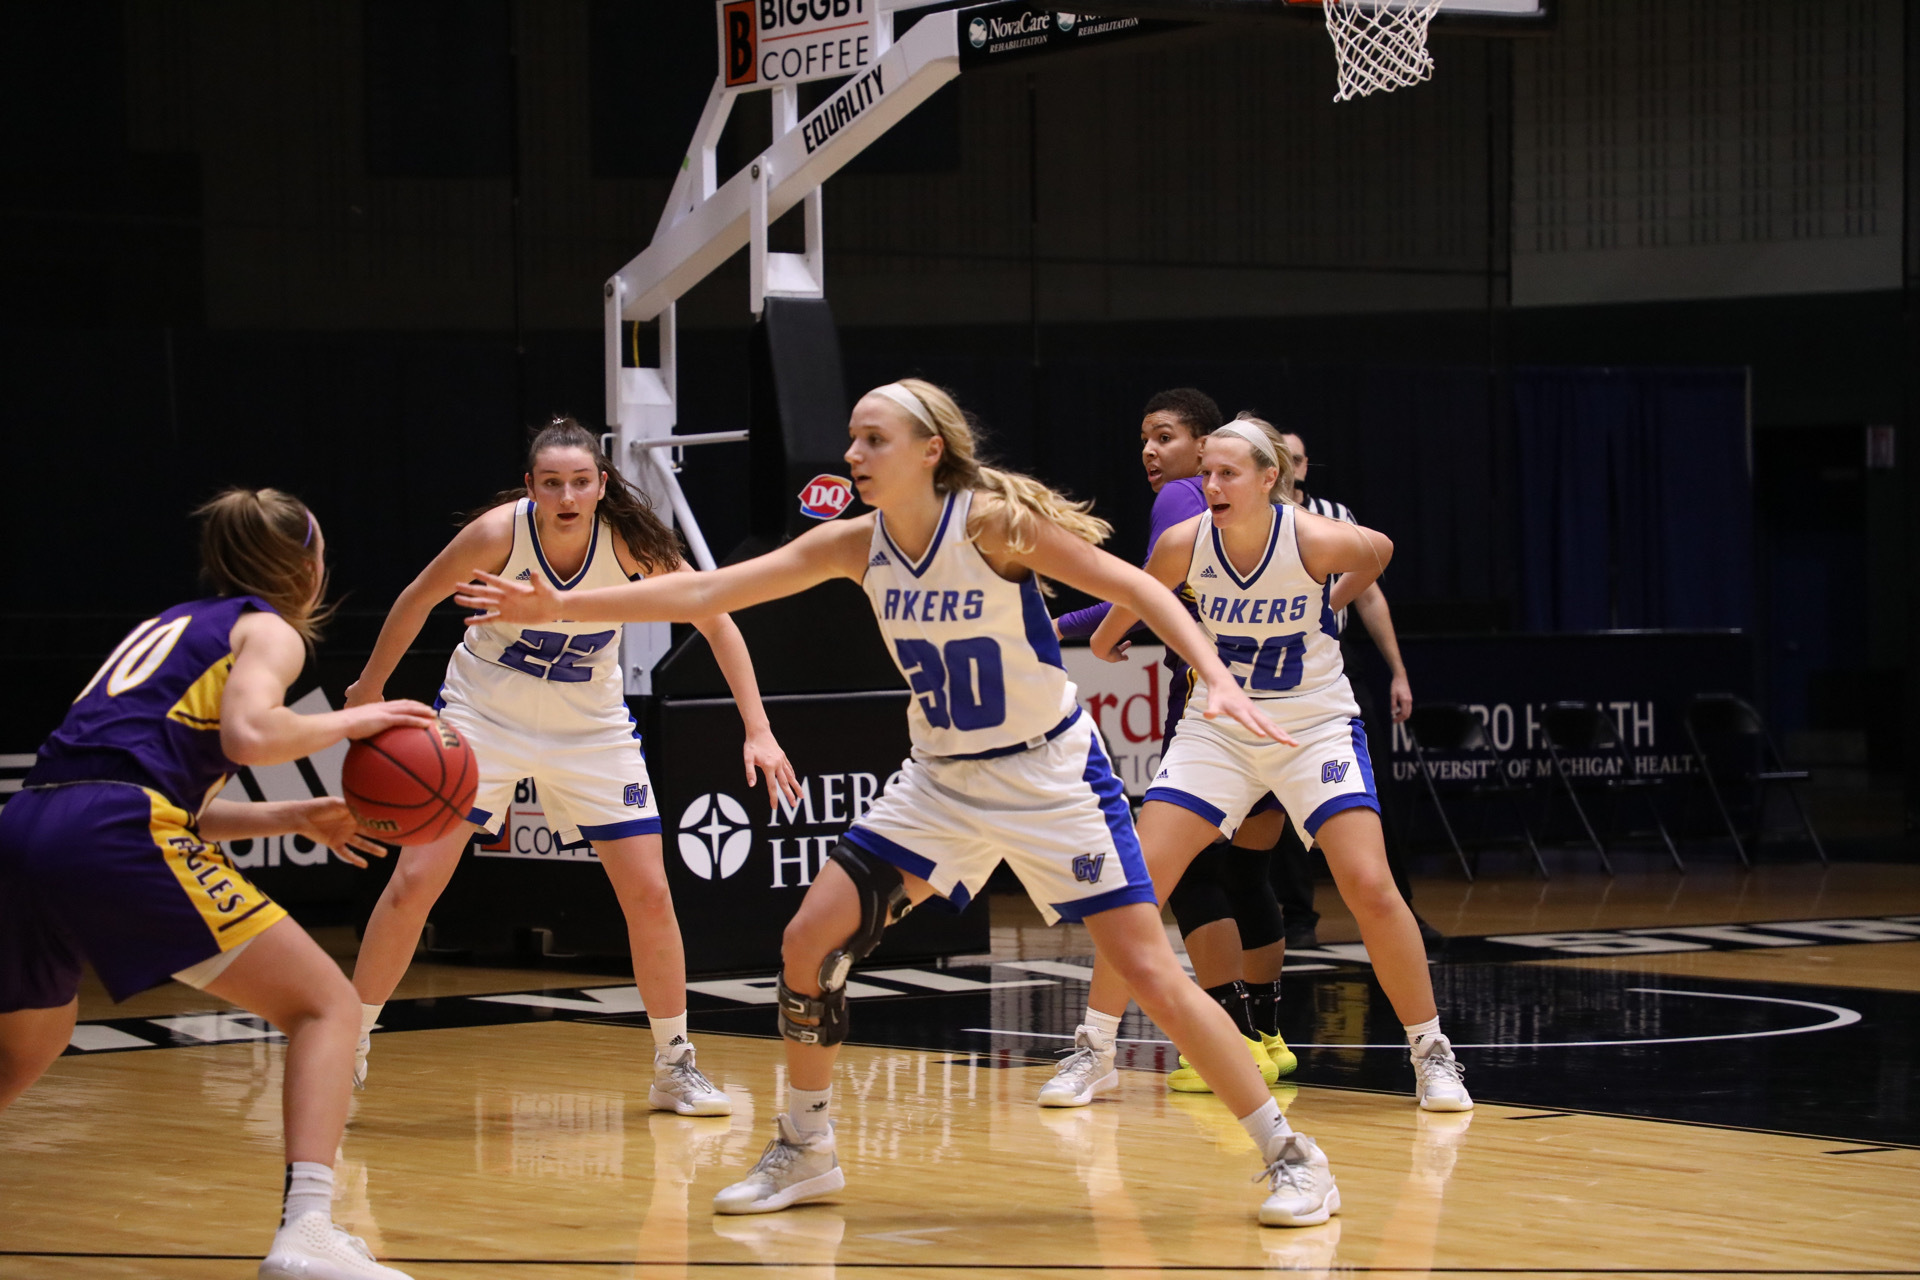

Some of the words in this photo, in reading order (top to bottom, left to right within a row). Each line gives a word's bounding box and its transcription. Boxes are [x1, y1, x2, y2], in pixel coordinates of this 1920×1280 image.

[988, 12, 1050, 39] NovaCare
[1078, 18, 1139, 37] REHABILITATION
[730, 11, 752, 80] B
[762, 36, 869, 81] COFFEE
[989, 35, 1048, 53] REHABILITATION
[802, 64, 884, 154] EQUALITY
[808, 485, 845, 510] DQ
[883, 589, 984, 621] AKERS
[72, 615, 192, 704] 10
[497, 629, 616, 682] 22
[1215, 631, 1307, 691] 20
[893, 636, 1006, 731] 30
[1321, 760, 1350, 783] GV
[1507, 757, 1532, 778] OF
[1634, 754, 1706, 775] HEALT
[623, 783, 648, 808] GV
[1485, 914, 1920, 955] STA
